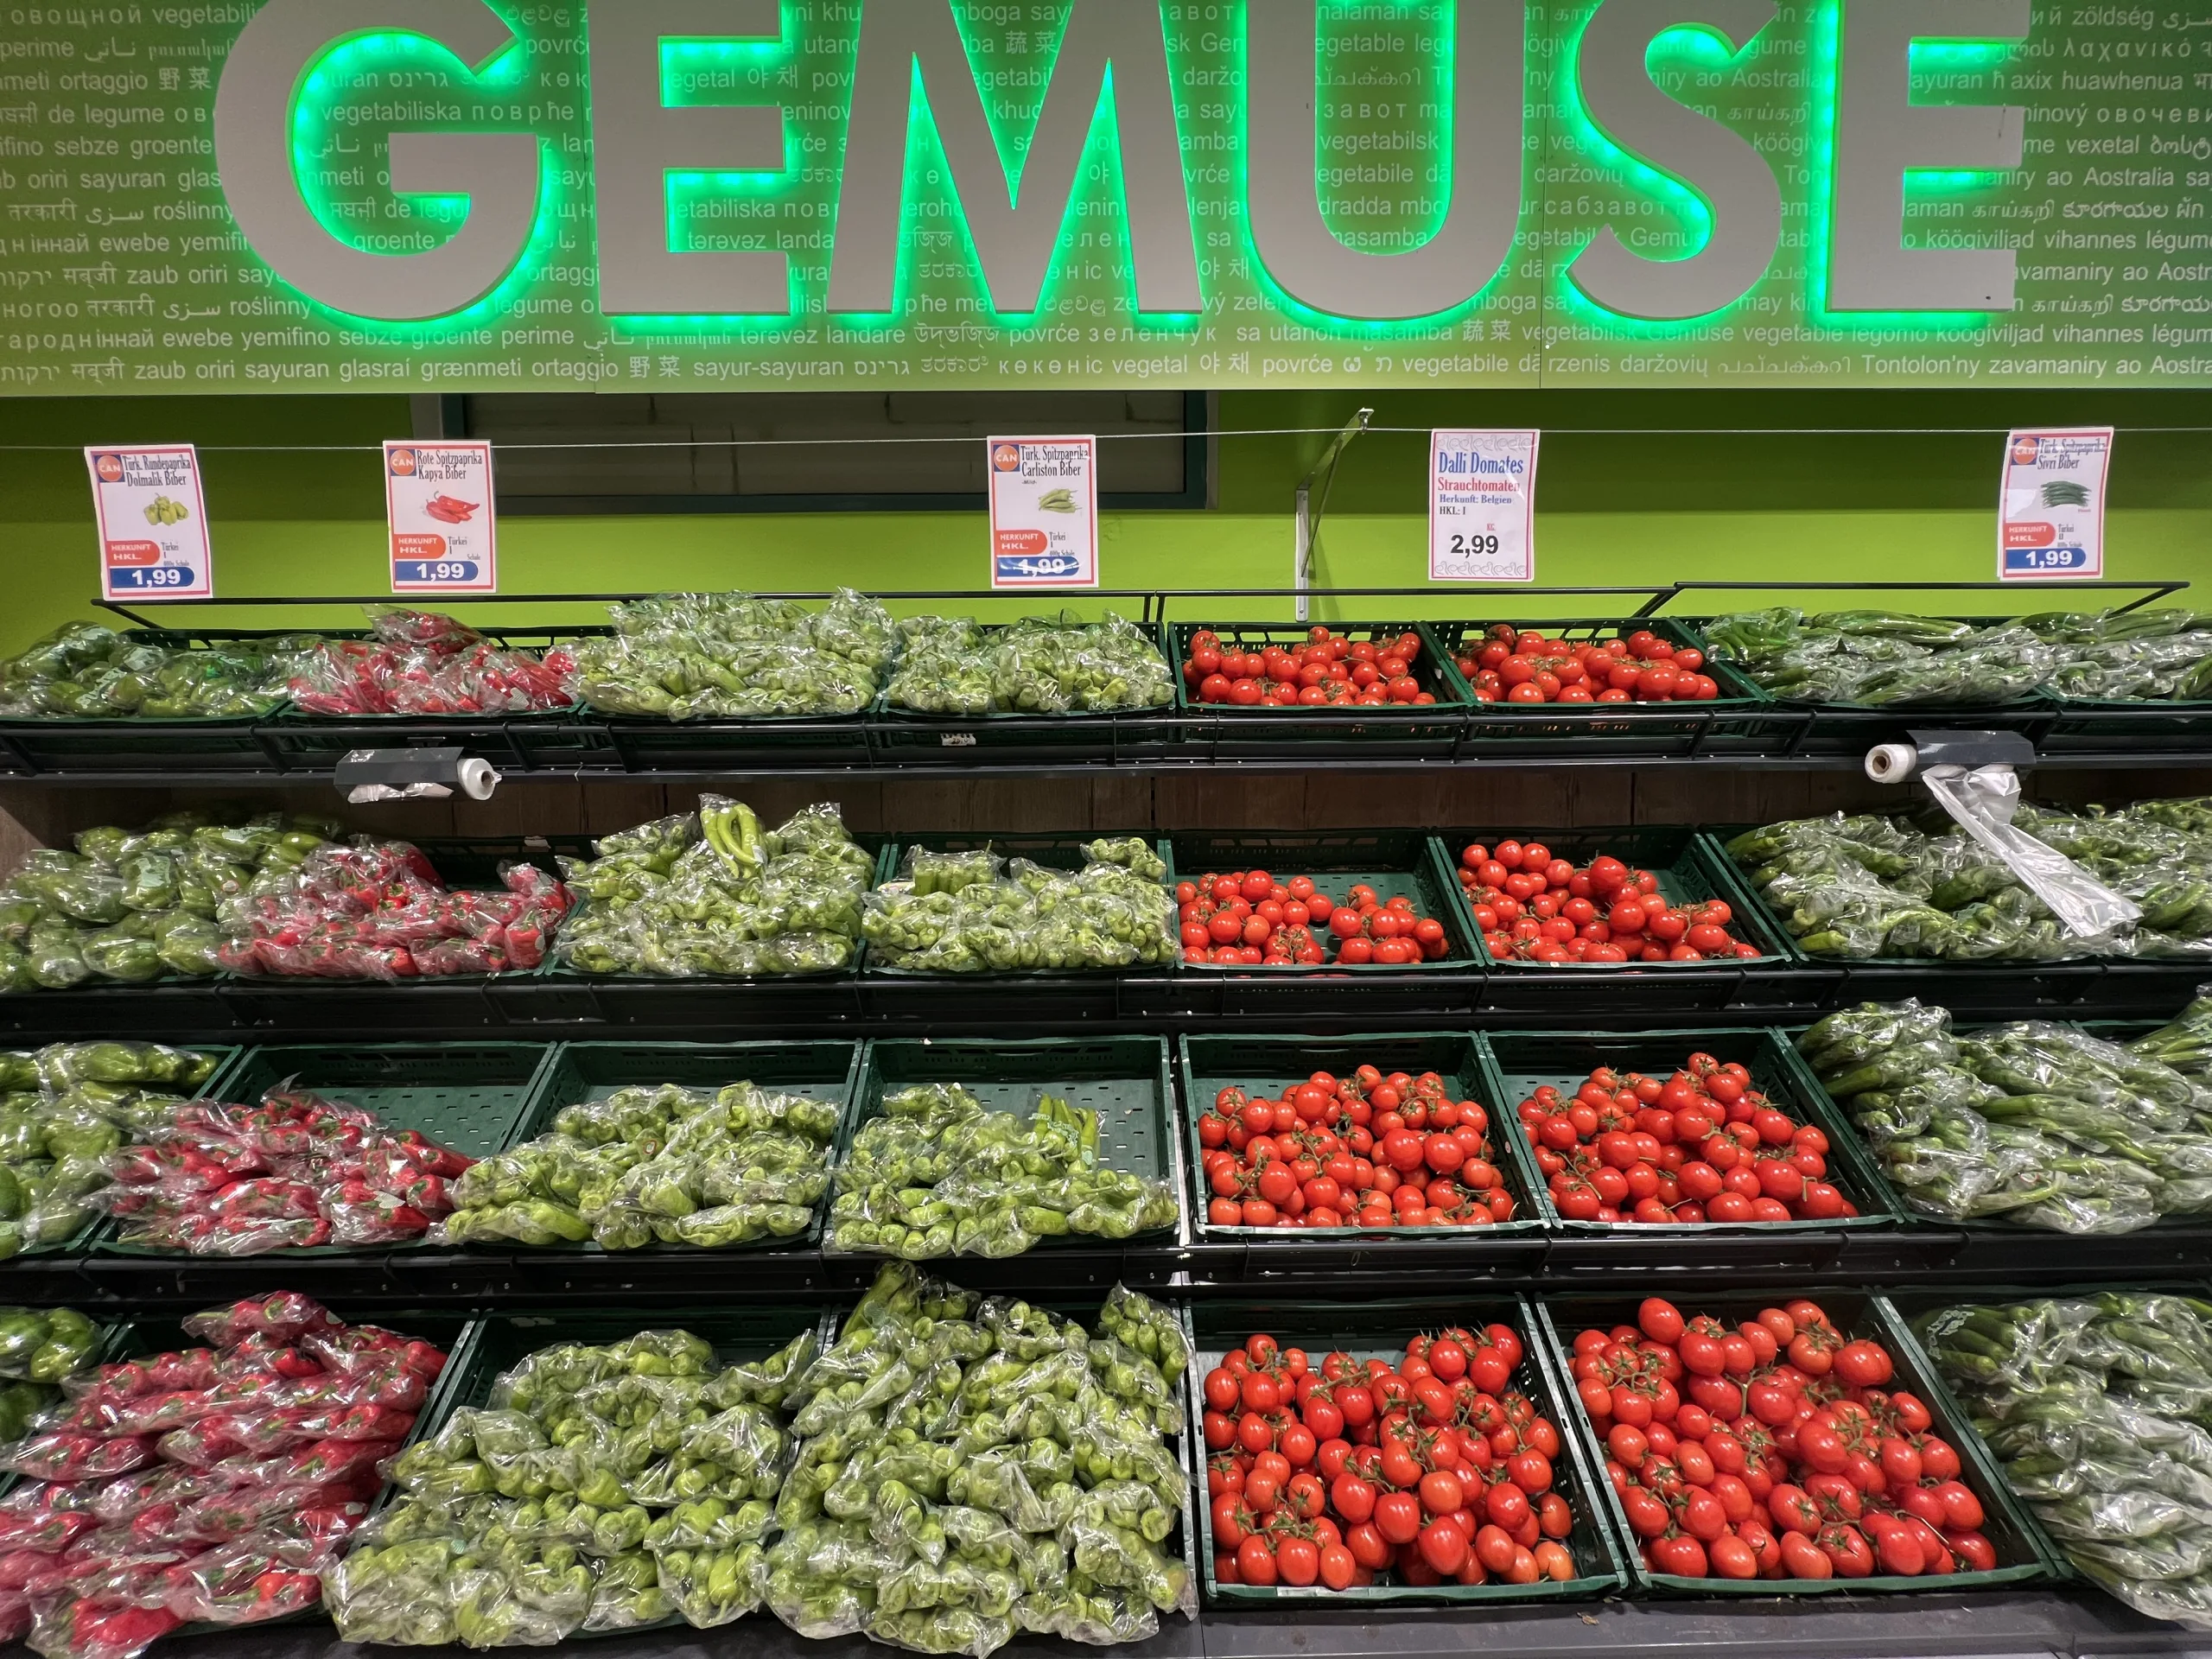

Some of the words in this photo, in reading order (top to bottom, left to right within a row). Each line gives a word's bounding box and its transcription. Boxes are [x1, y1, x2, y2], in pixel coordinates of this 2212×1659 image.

[2072, 6, 2154, 30] zöldség
[1, 37, 74, 61] perime
[525, 34, 588, 62] povrć
[1315, 33, 1404, 60] egetable
[60, 70, 148, 95] ortaggio
[1696, 73, 1722, 88] ao
[2062, 70, 2183, 91] huawhenua
[48, 104, 75, 124] de
[86, 103, 165, 128] legume
[321, 100, 461, 126] vegetabiliska
[54, 137, 119, 156] sebze
[130, 137, 213, 160] groente
[1319, 130, 1440, 155] vegetabilsk
[2067, 135, 2139, 155] vexetal
[28, 169, 68, 189] oriri
[79, 169, 166, 196] sayuran
[1316, 164, 1414, 188] egetabile
[2047, 173, 2073, 187] ao
[2083, 168, 2174, 188] Aostralia
[385, 200, 411, 219] de
[99, 232, 170, 252] ewebe
[1206, 231, 1231, 247] sa
[2044, 230, 2136, 250] vihannes
[127, 263, 178, 284] zaub
[188, 262, 228, 283] oriri
[526, 263, 600, 286] ortaggi
[2123, 266, 2149, 282] ao
[162, 327, 233, 347] ewebe
[241, 327, 331, 352] yemifino
[339, 326, 403, 346] sebze
[411, 325, 493, 349] groente
[502, 324, 575, 349] perime
[827, 324, 906, 345] landare
[1009, 322, 1081, 347] povrće
[1236, 325, 1262, 342] sa
[1269, 324, 1341, 342] utanon
[1351, 320, 1453, 342] masamba
[1522, 321, 1637, 347] vegetabilsk
[1645, 321, 1734, 343] Gemüse
[1743, 321, 1844, 347] vegetable
[2052, 323, 2144, 343] vihannes
[135, 359, 186, 380] zaub
[195, 359, 235, 379] oriri
[245, 359, 329, 386] sayuran
[340, 358, 411, 382] glasraí
[421, 357, 522, 382] grænmeti
[531, 358, 619, 382] ortaggio
[693, 358, 844, 382] sayur-sayuran
[1112, 353, 1188, 378] vegetal
[1263, 352, 1333, 378] povrće
[1402, 353, 1509, 378] vegetabile
[1620, 352, 1708, 378] daržovių
[1988, 355, 2107, 379] zavamaniry
[2115, 358, 2142, 374] ao
[391, 458, 415, 467] CAN
[416, 449, 435, 465] Rote
[435, 448, 482, 468] Spitzpaprika
[995, 454, 1018, 462] CAN
[1020, 446, 1040, 461] Türk.
[1439, 451, 1467, 474] Dalli
[1470, 451, 1523, 474] Domates
[99, 464, 121, 473] CAN
[166, 471, 187, 486] Biber
[418, 465, 443, 482] Kapya
[445, 465, 467, 480] Biber
[1022, 462, 1058, 476] Carliston
[1060, 461, 1081, 476] Biber
[1440, 494, 1479, 504] Herkunft:
[1481, 494, 1512, 505] Belgien
[1450, 534, 1499, 558] 2,99
[2025, 550, 2073, 569] 1,99
[131, 569, 181, 588] 1,99
[416, 563, 465, 582] 1,99
